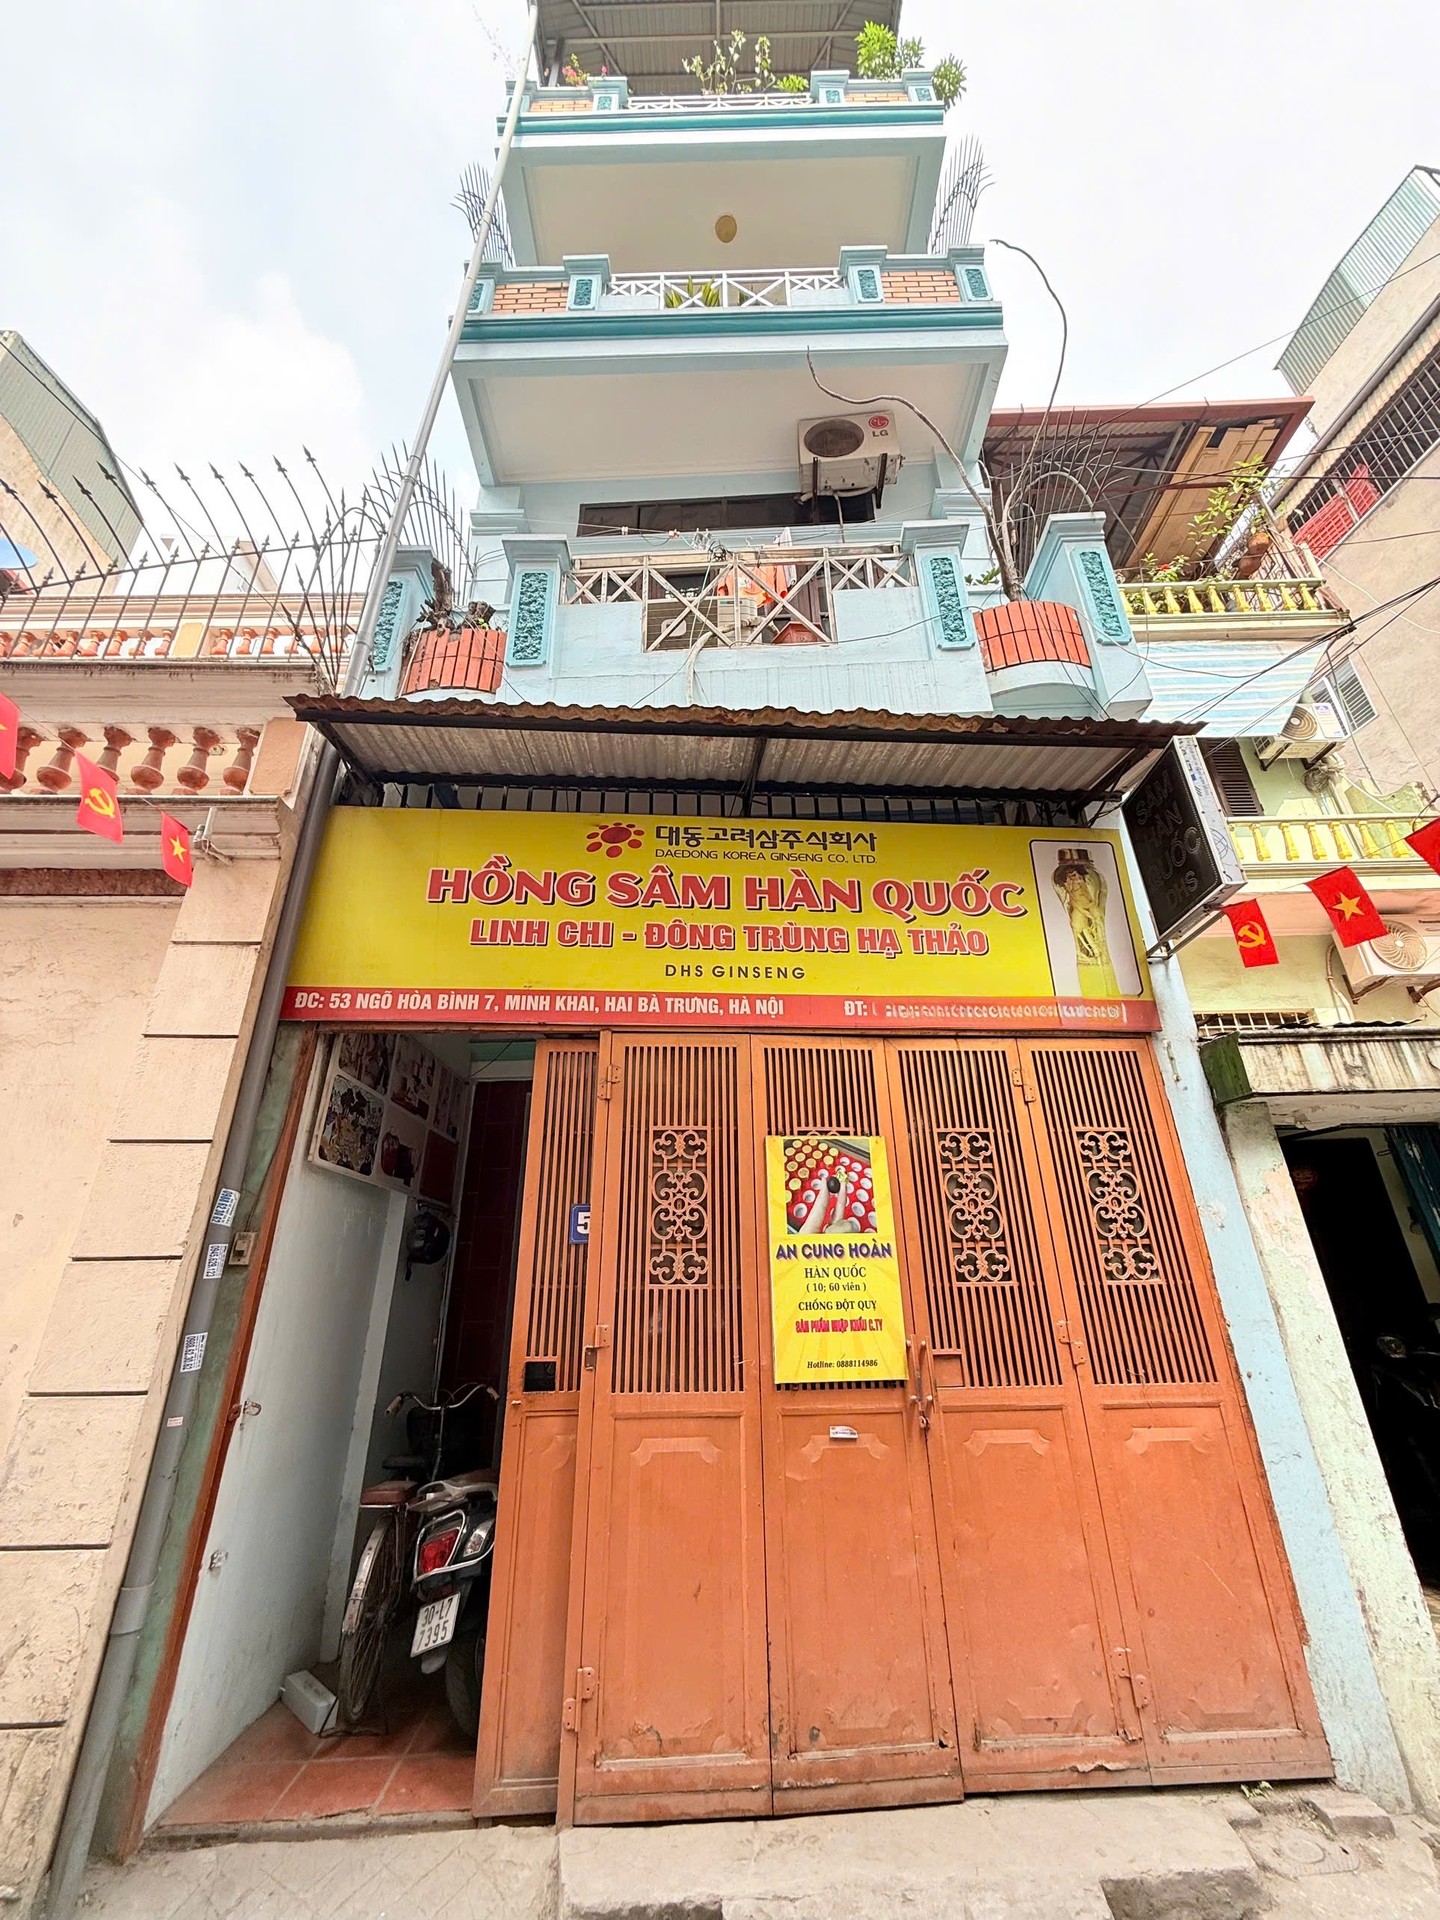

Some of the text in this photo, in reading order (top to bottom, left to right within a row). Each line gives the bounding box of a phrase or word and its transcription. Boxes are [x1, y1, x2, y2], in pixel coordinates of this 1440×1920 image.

[872, 429, 889, 437] LG
[655, 825, 878, 852] 대동고려삼주식회사
[655, 849, 719, 860] DAEDONG
[723, 850, 767, 861] KOREA
[769, 852, 823, 863] GINSENG
[852, 855, 878, 864] LTD.
[427, 854, 1028, 923] HỒNG SÂM HÀN QUỐC
[469, 918, 990, 959] LINH CHI - ĐÔNG TRÙNG HẠ THẢO
[665, 964, 806, 980] DHS GINSENG
[294, 990, 784, 1019] ĐC: 53 NGÕ HÒA BÌNH 7, MINH KHAI, HAI BÀ TRƯNG, HÀ NỘI
[843, 1000, 868, 1016] ĐT:
[776, 1238, 892, 1260] AN CUNG HOÀN
[804, 1263, 867, 1280] HÀN QUỐC
[829, 1283, 840, 1292] 60
[842, 1282, 861, 1291] viên
[798, 1298, 833, 1311] CHỐNG
[836, 1298, 855, 1312] ĐỘT
[807, 1359, 878, 1369] Hotline: 0888114986
[422, 1597, 454, 1628] 30-L7
[417, 1619, 449, 1651] 7395
